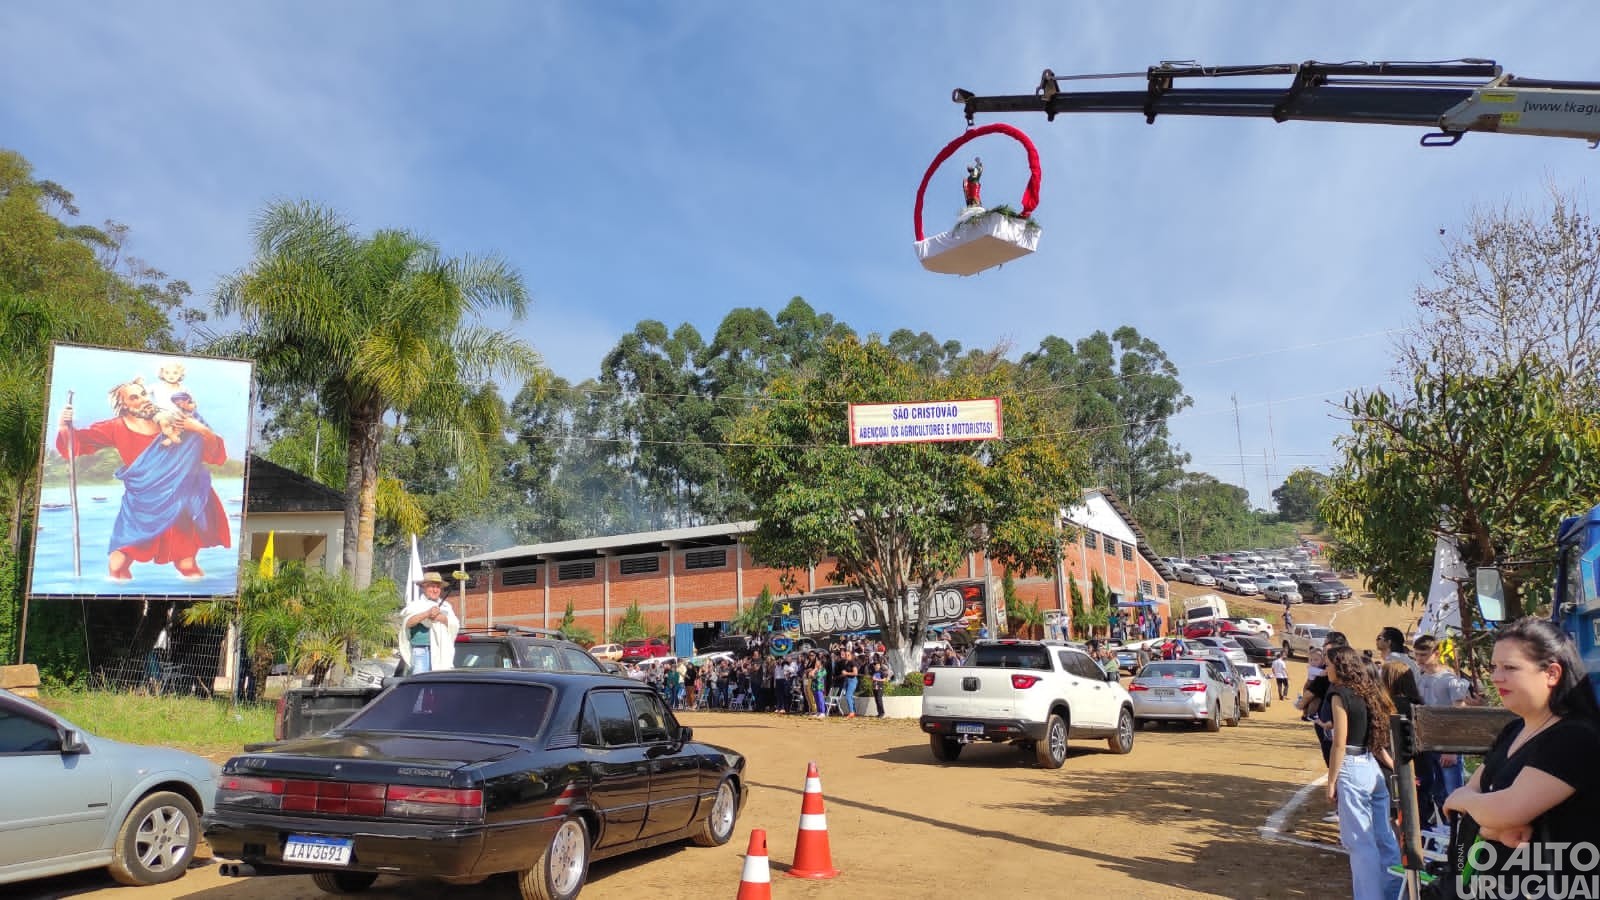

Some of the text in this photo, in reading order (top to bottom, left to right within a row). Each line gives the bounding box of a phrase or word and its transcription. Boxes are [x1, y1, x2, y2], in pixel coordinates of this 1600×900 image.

[892, 404, 958, 420] SÃO CRISTÓVÃO
[890, 425, 899, 438] OS
[900, 423, 945, 437] AGRICULTORES
[952, 422, 993, 435] MOTORISTAS!
[801, 601, 866, 634] NOVO
[289, 843, 343, 861] IAV3G91
